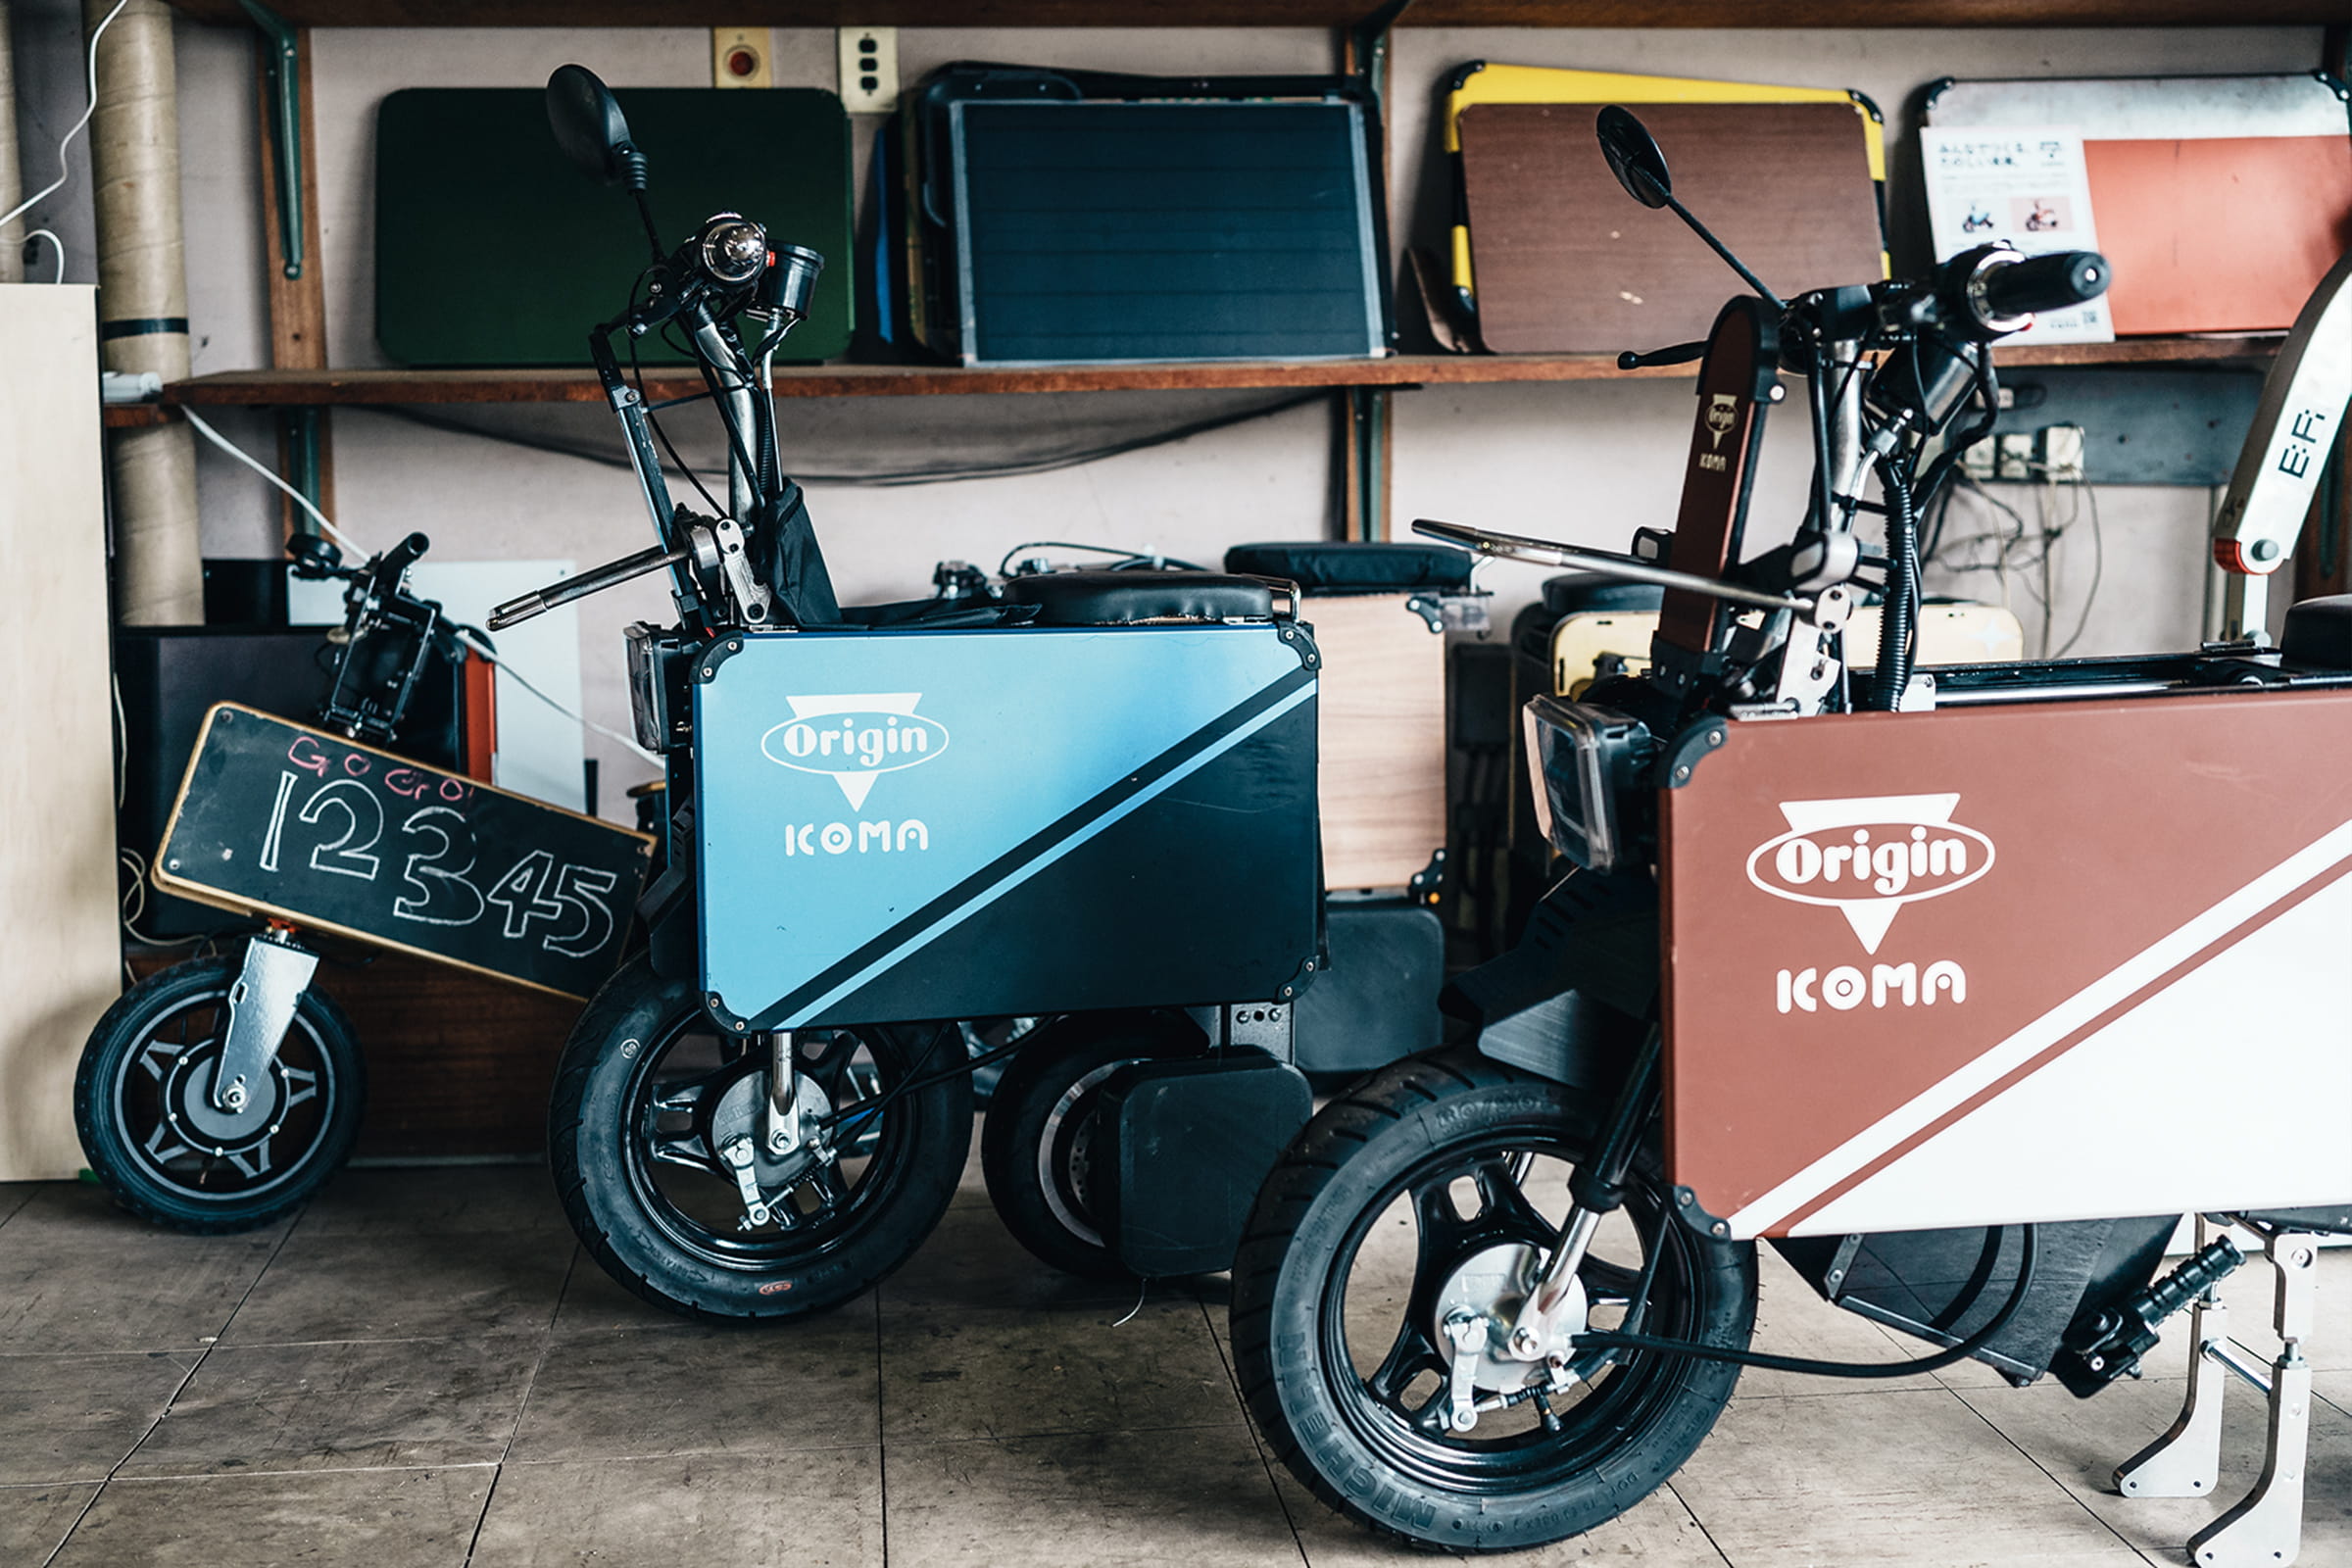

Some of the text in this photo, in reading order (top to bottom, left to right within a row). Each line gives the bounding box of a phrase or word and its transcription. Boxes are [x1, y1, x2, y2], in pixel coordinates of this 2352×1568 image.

[784, 716, 928, 767] Origin
[1776, 825, 1967, 896] Origin
[1277, 1331, 1438, 1532] MICHELIN
